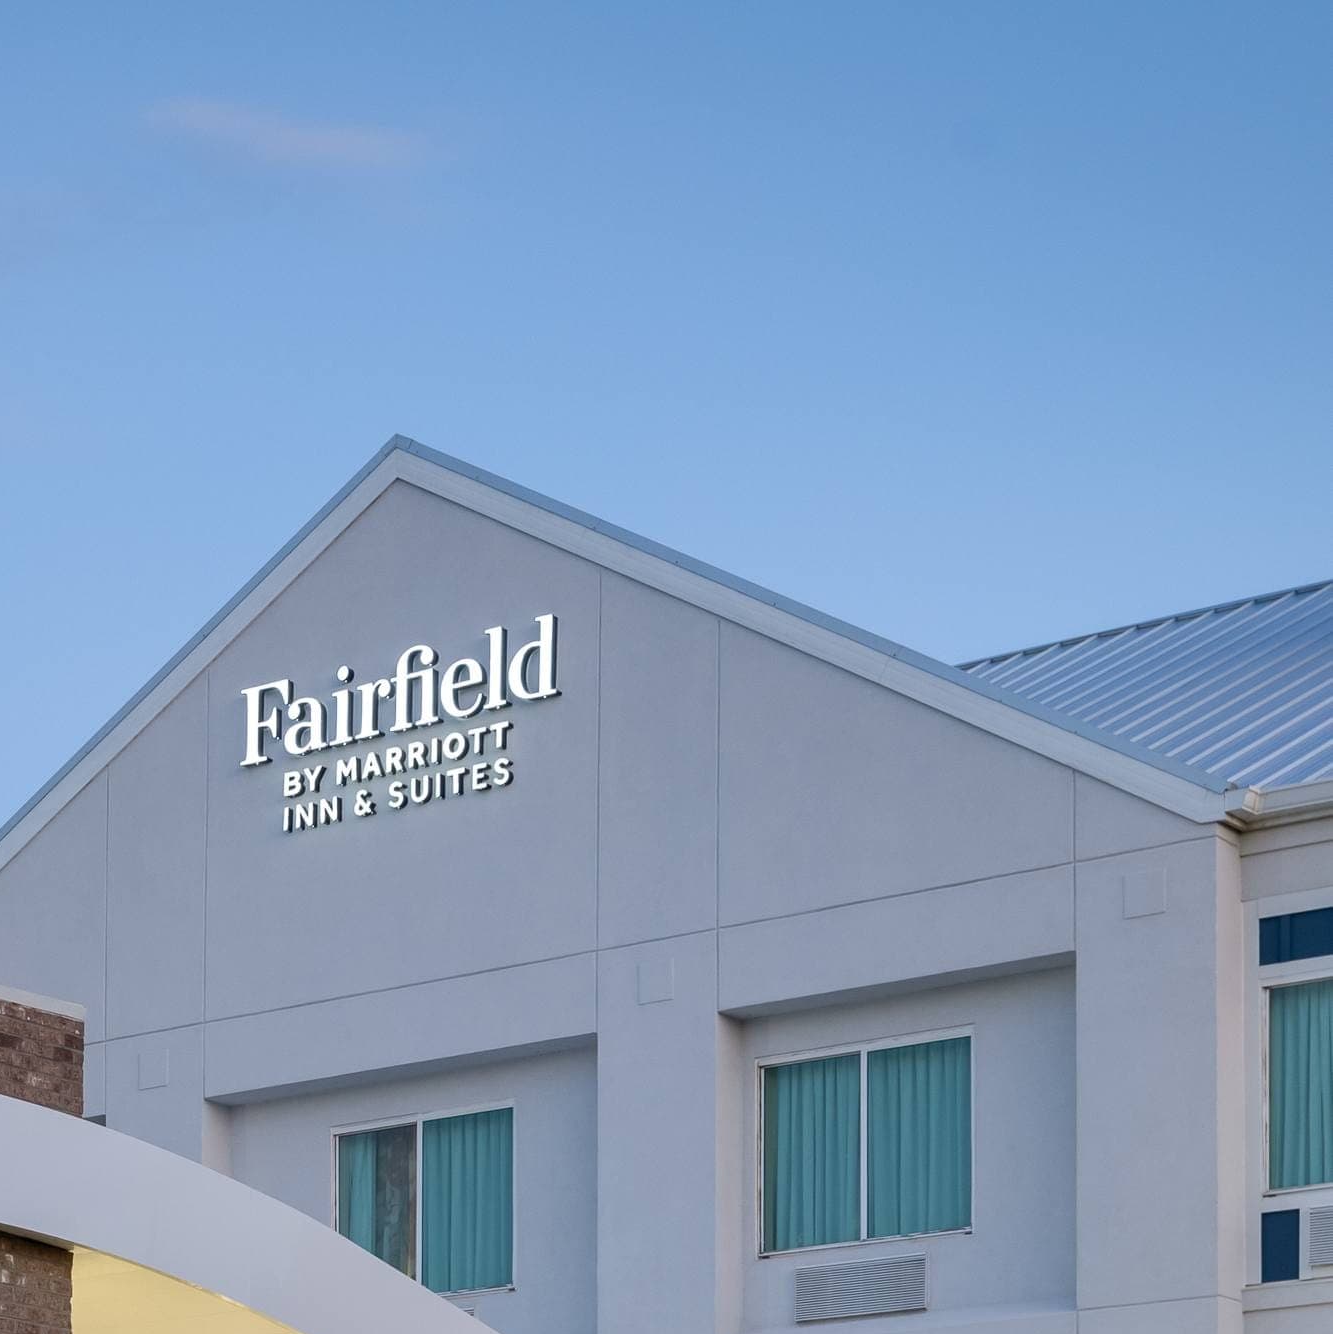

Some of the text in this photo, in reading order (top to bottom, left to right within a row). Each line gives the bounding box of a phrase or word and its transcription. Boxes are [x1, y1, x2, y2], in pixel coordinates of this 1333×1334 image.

[240, 613, 562, 766] Fairfield
[282, 758, 514, 833] INN & SUITES
[283, 721, 514, 797] BY MARRIOTT
